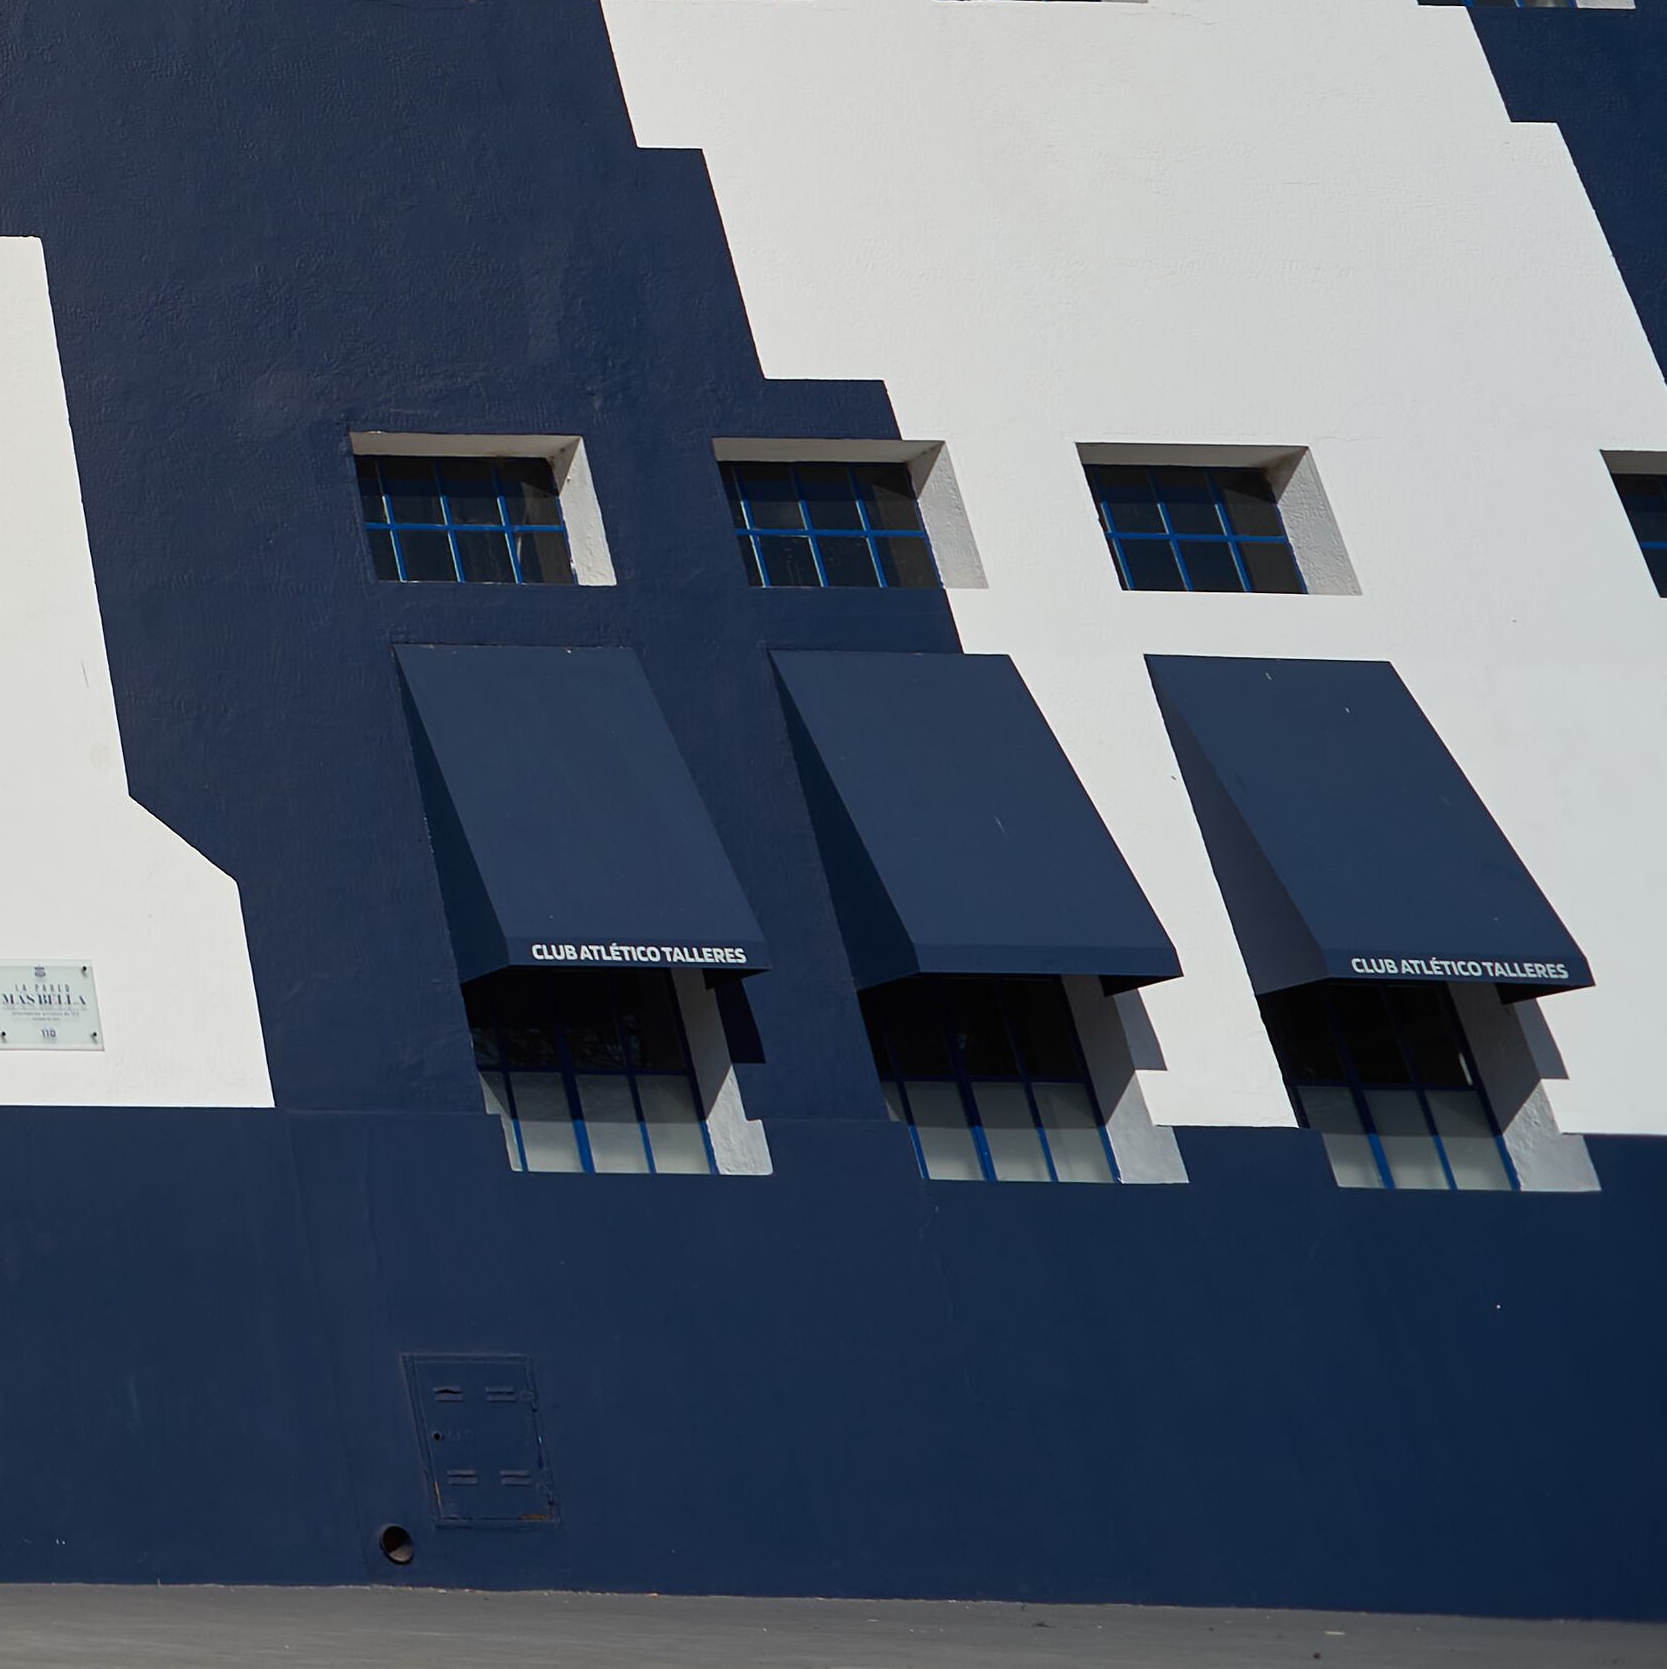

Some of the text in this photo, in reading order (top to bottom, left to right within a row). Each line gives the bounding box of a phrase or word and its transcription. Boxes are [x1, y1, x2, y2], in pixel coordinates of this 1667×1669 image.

[531, 942, 747, 964] CLUB ATLÉTICO TALLERES
[1351, 956, 1569, 980] CLUB ATLÉTICO TALLERES
